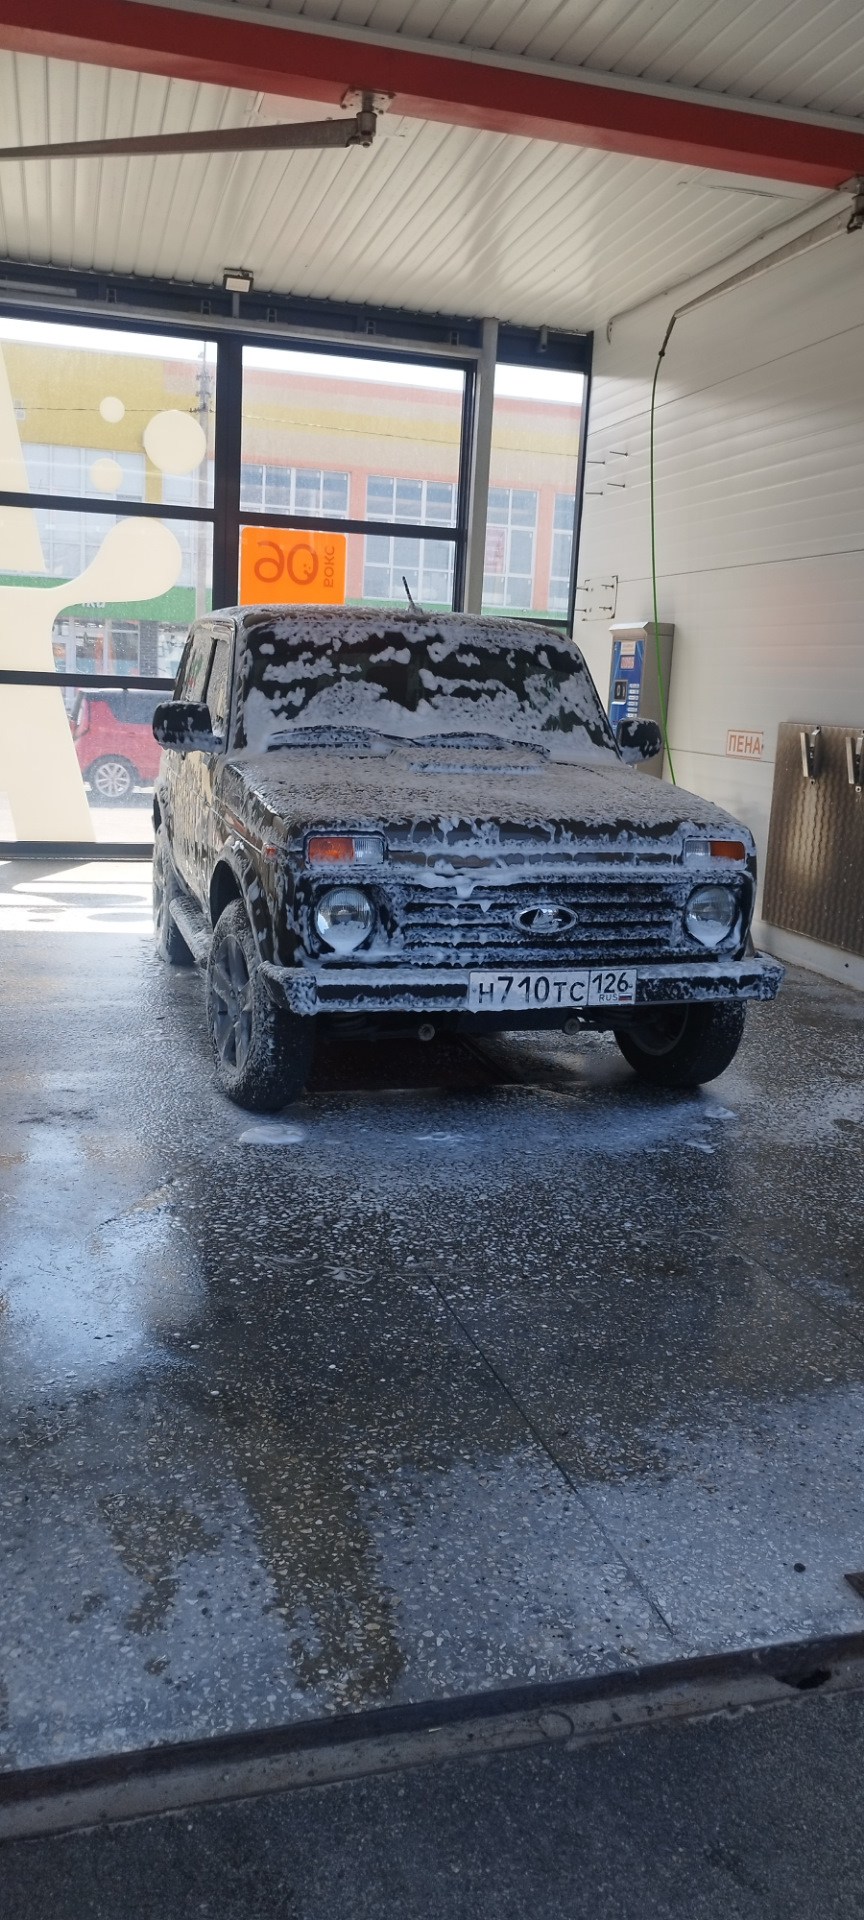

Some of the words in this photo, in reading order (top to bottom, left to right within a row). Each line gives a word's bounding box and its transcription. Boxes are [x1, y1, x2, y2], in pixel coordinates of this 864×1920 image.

[728, 734, 761, 755] ПЕНА
[478, 975, 586, 1004] Н710ТС
[592, 972, 630, 994] 126
[598, 993, 618, 1002] RUS
